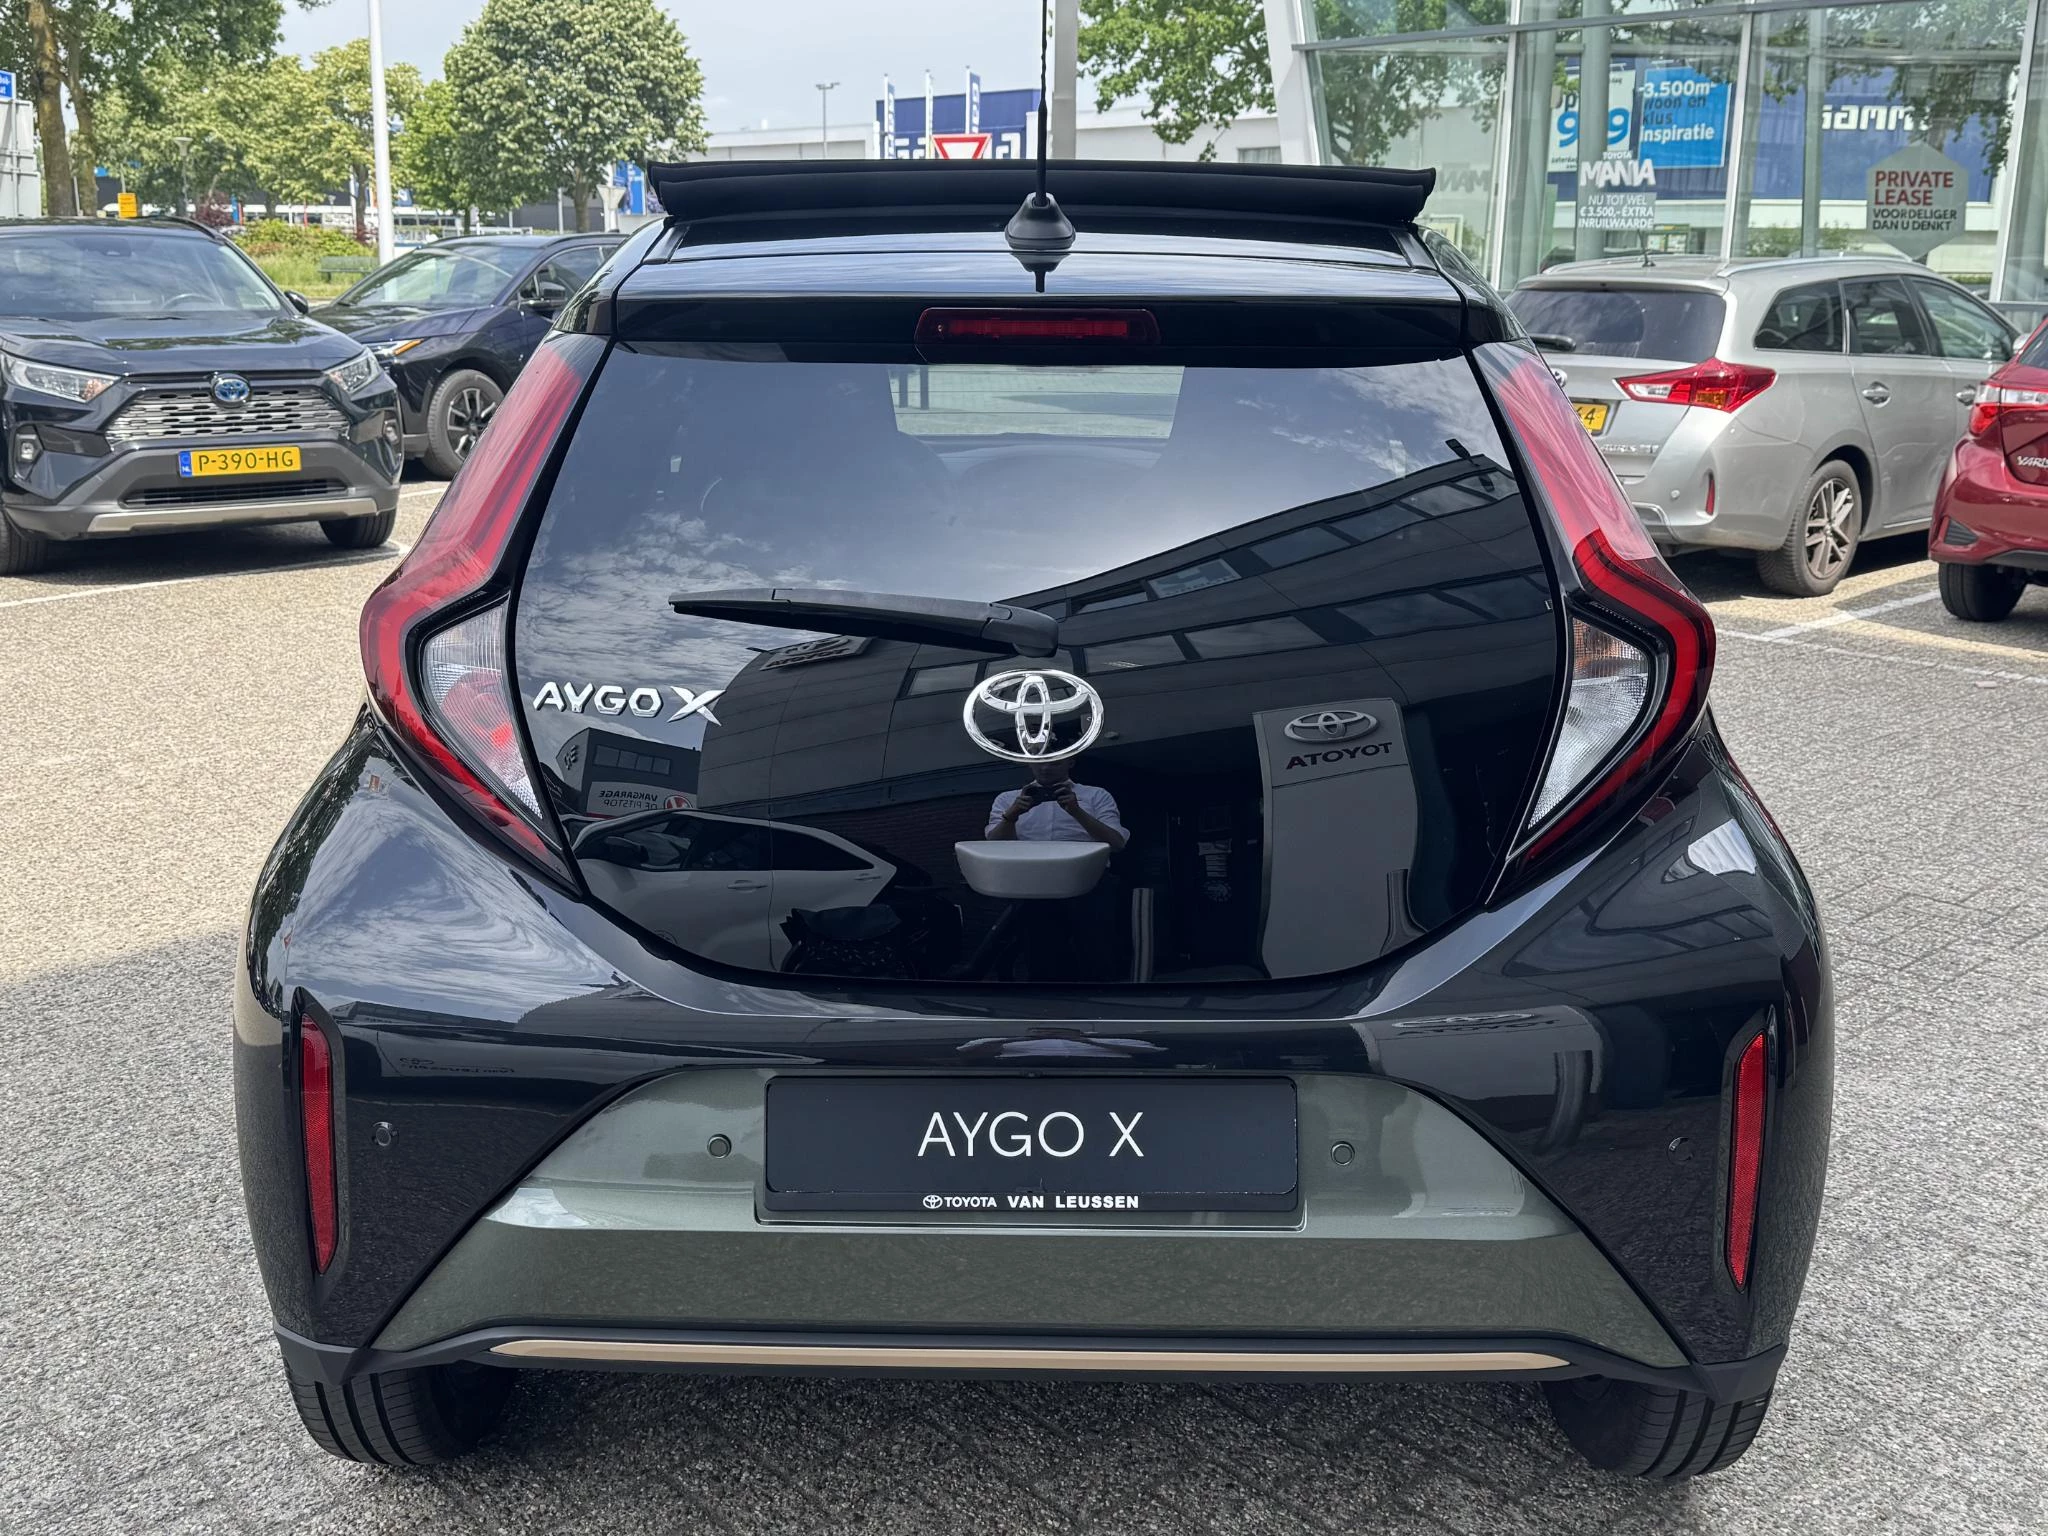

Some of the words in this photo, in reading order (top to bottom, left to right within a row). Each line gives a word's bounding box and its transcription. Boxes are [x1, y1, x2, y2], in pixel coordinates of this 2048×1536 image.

[1640, 123, 1715, 144] inspiratie
[1602, 151, 1632, 161] TOYOTA
[1580, 159, 1656, 188] MANIA
[1875, 170, 1954, 188] PRIVATE
[1588, 195, 1604, 206] NU
[1606, 194, 1625, 206] TOT
[1627, 193, 1647, 205] WEL
[1874, 189, 1934, 206] LEASE
[1873, 208, 1957, 219] VOORDELIGER
[1578, 217, 1653, 229] INRUILWAARDE
[1873, 220, 1899, 230] DAN
[1901, 220, 1909, 230] U
[1912, 221, 1951, 231] DENKT
[198, 450, 294, 472] P-390-HG
[533, 681, 664, 718] AYGO
[666, 685, 727, 727] X
[917, 1111, 1085, 1157] AYGO
[1109, 1111, 1145, 1157] X
[944, 1196, 998, 1208] TOYOTA
[1007, 1195, 1045, 1208] VAN
[1055, 1195, 1139, 1208] LEUSSEN
